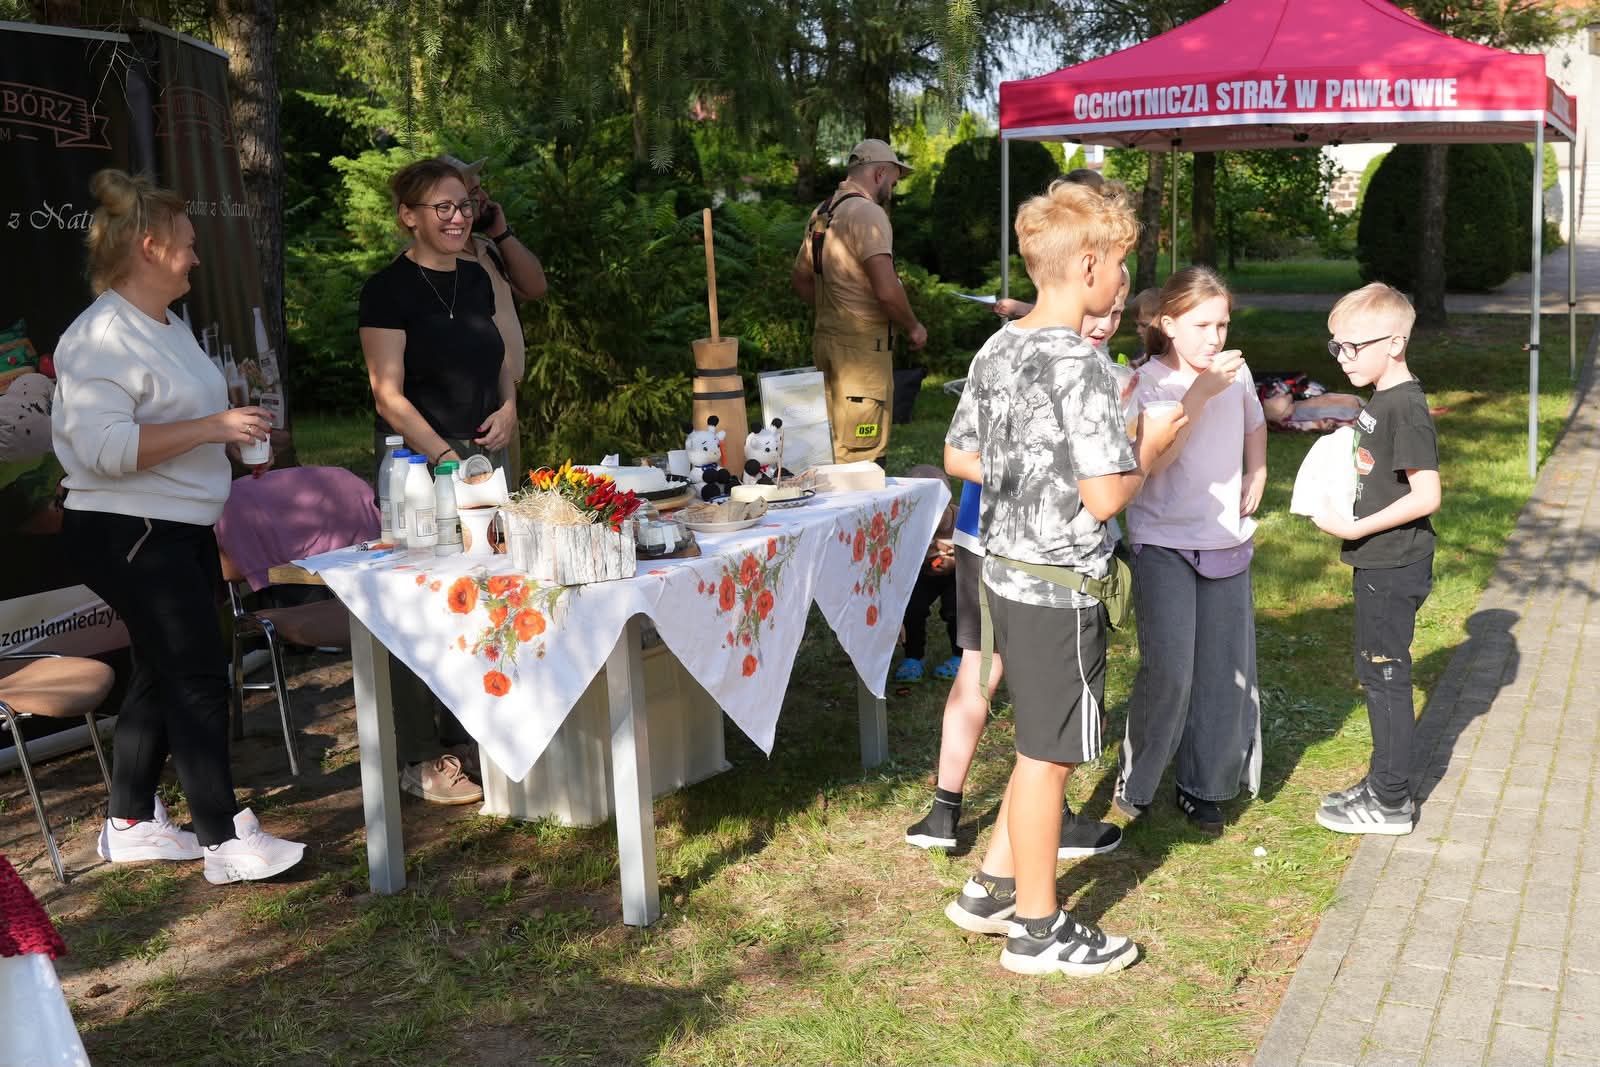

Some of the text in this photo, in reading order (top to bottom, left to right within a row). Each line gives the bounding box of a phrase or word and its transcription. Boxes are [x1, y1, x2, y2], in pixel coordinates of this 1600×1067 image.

[1073, 73, 1457, 121] OCHOTNICZA STRAŻ W PAWŁOWIE
[7, 212, 21, 230] z
[859, 426, 875, 435] OSP
[0, 608, 121, 647] zarniamiedzy
